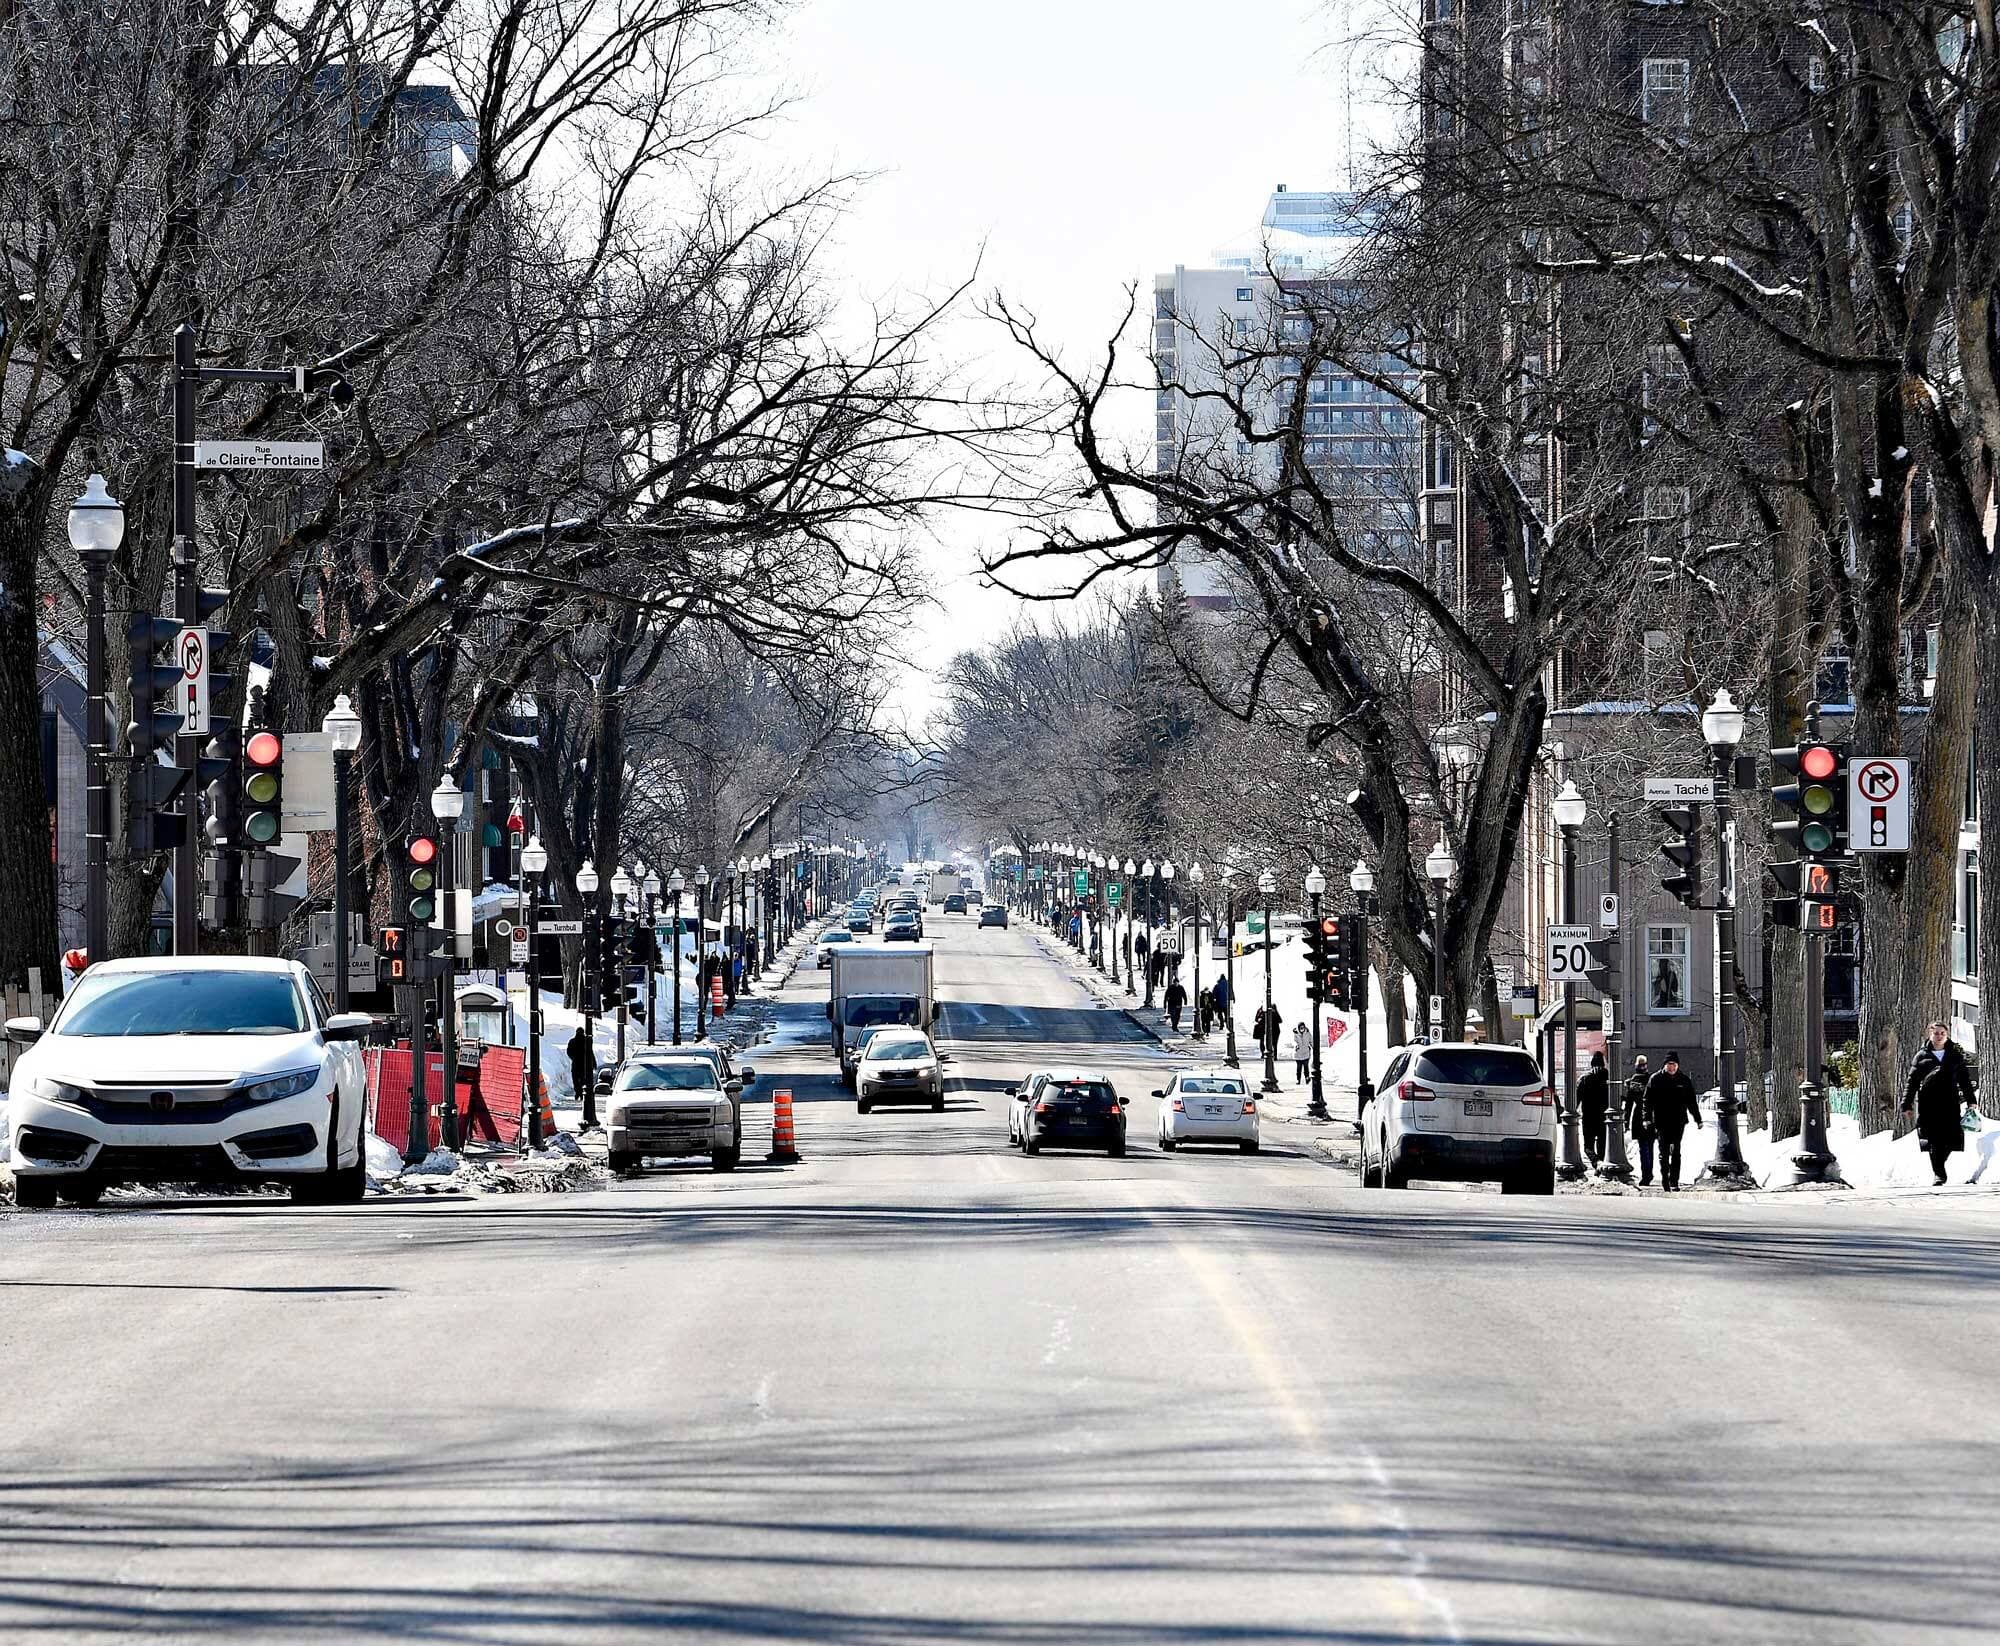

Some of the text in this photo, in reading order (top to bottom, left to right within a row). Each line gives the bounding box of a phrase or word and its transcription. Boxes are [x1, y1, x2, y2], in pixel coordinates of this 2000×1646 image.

[206, 453, 320, 466] de Claire-Fontaine
[1674, 783, 1709, 795] Taché
[1109, 886, 1118, 897] P
[554, 923, 577, 932] Turnbull
[1550, 930, 1588, 939] MAXIMUM
[1162, 938, 1177, 950] 50
[1552, 944, 1586, 973] 50
